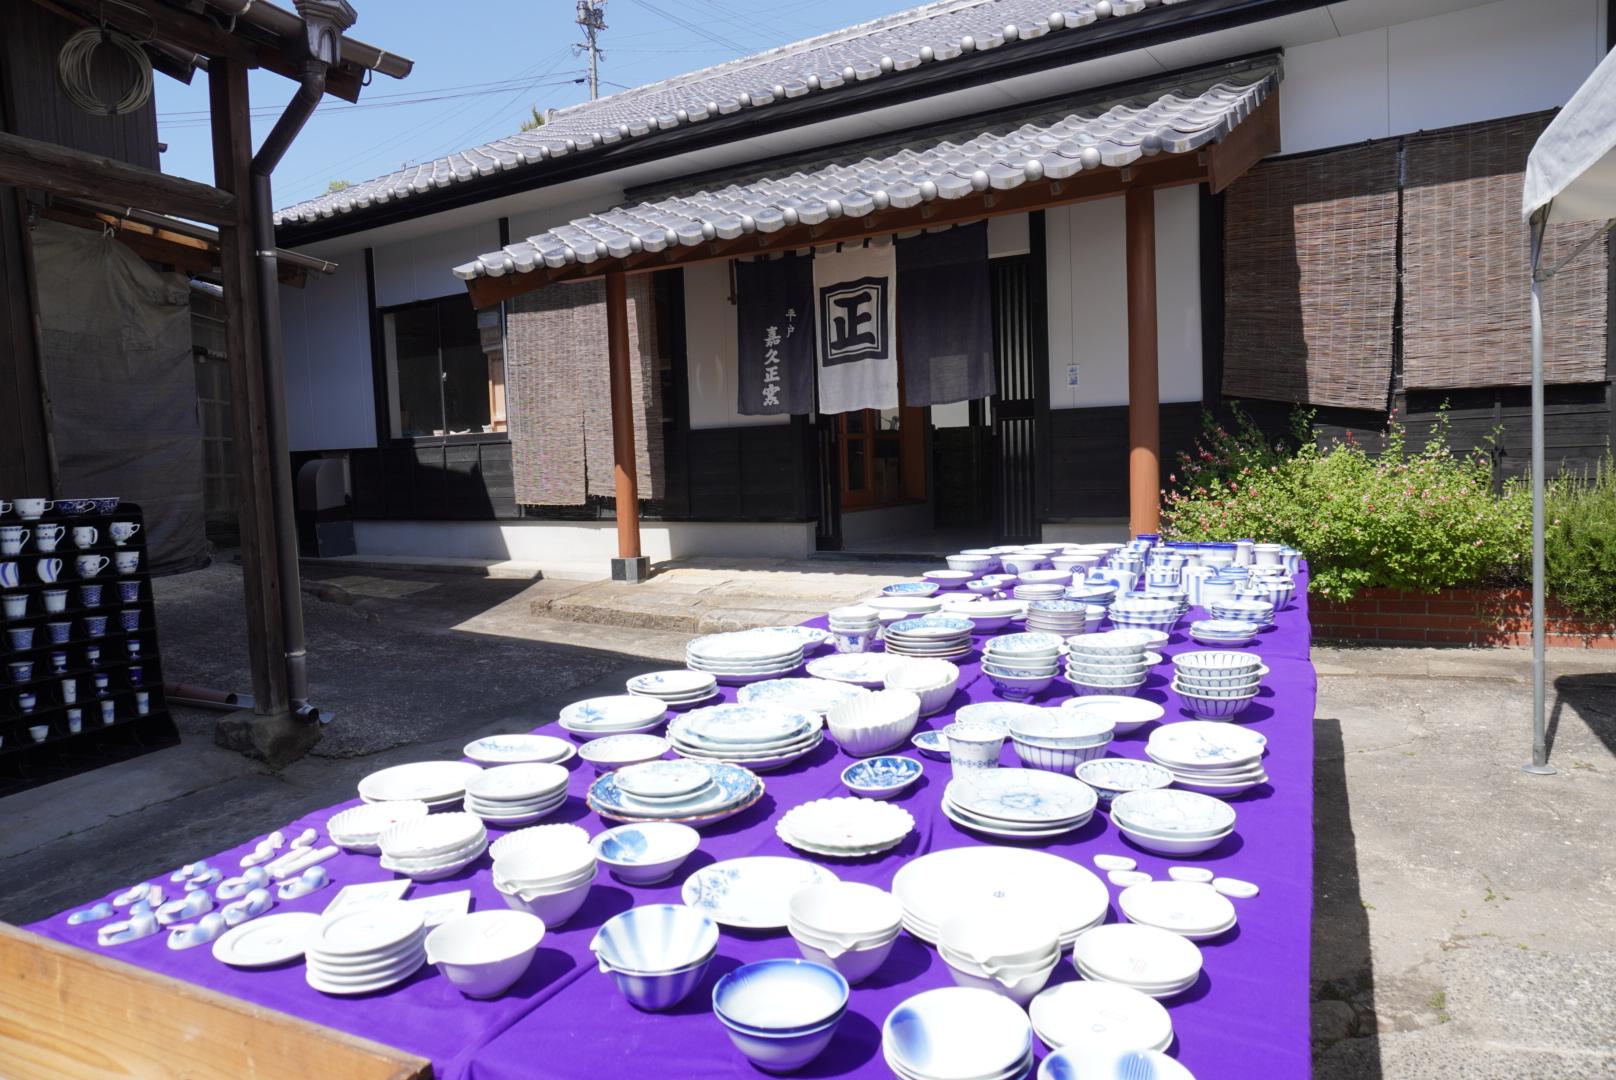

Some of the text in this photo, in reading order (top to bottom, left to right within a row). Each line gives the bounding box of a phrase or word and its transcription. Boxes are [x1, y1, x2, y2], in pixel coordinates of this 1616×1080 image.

[785, 308, 797, 338] 平戸
[830, 291, 876, 351] 正
[762, 325, 782, 407] 嘉久正窯
